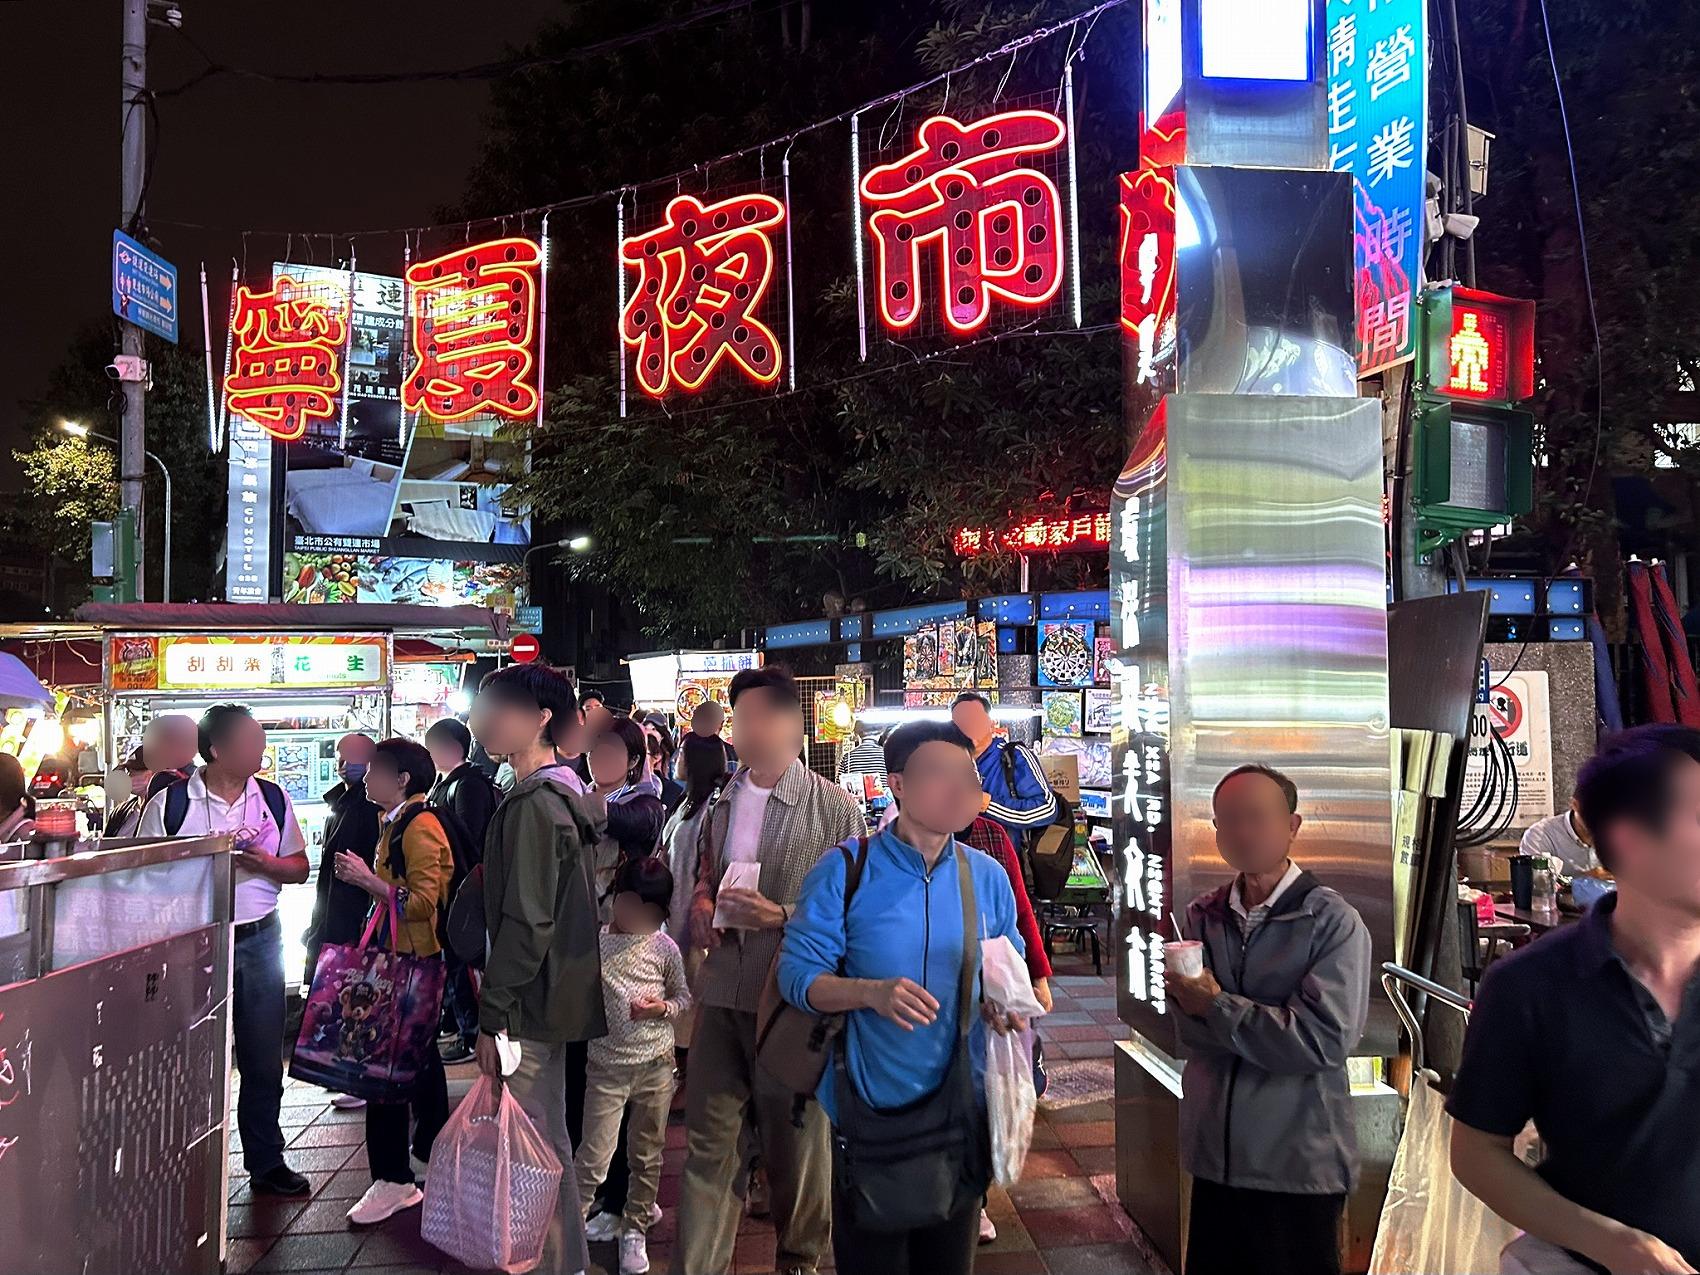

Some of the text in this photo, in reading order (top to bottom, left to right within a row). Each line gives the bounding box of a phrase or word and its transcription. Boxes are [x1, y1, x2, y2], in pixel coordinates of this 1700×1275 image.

[225, 108, 1067, 439] 寧夏夜市
[1360, 0, 1417, 370] 營業時間
